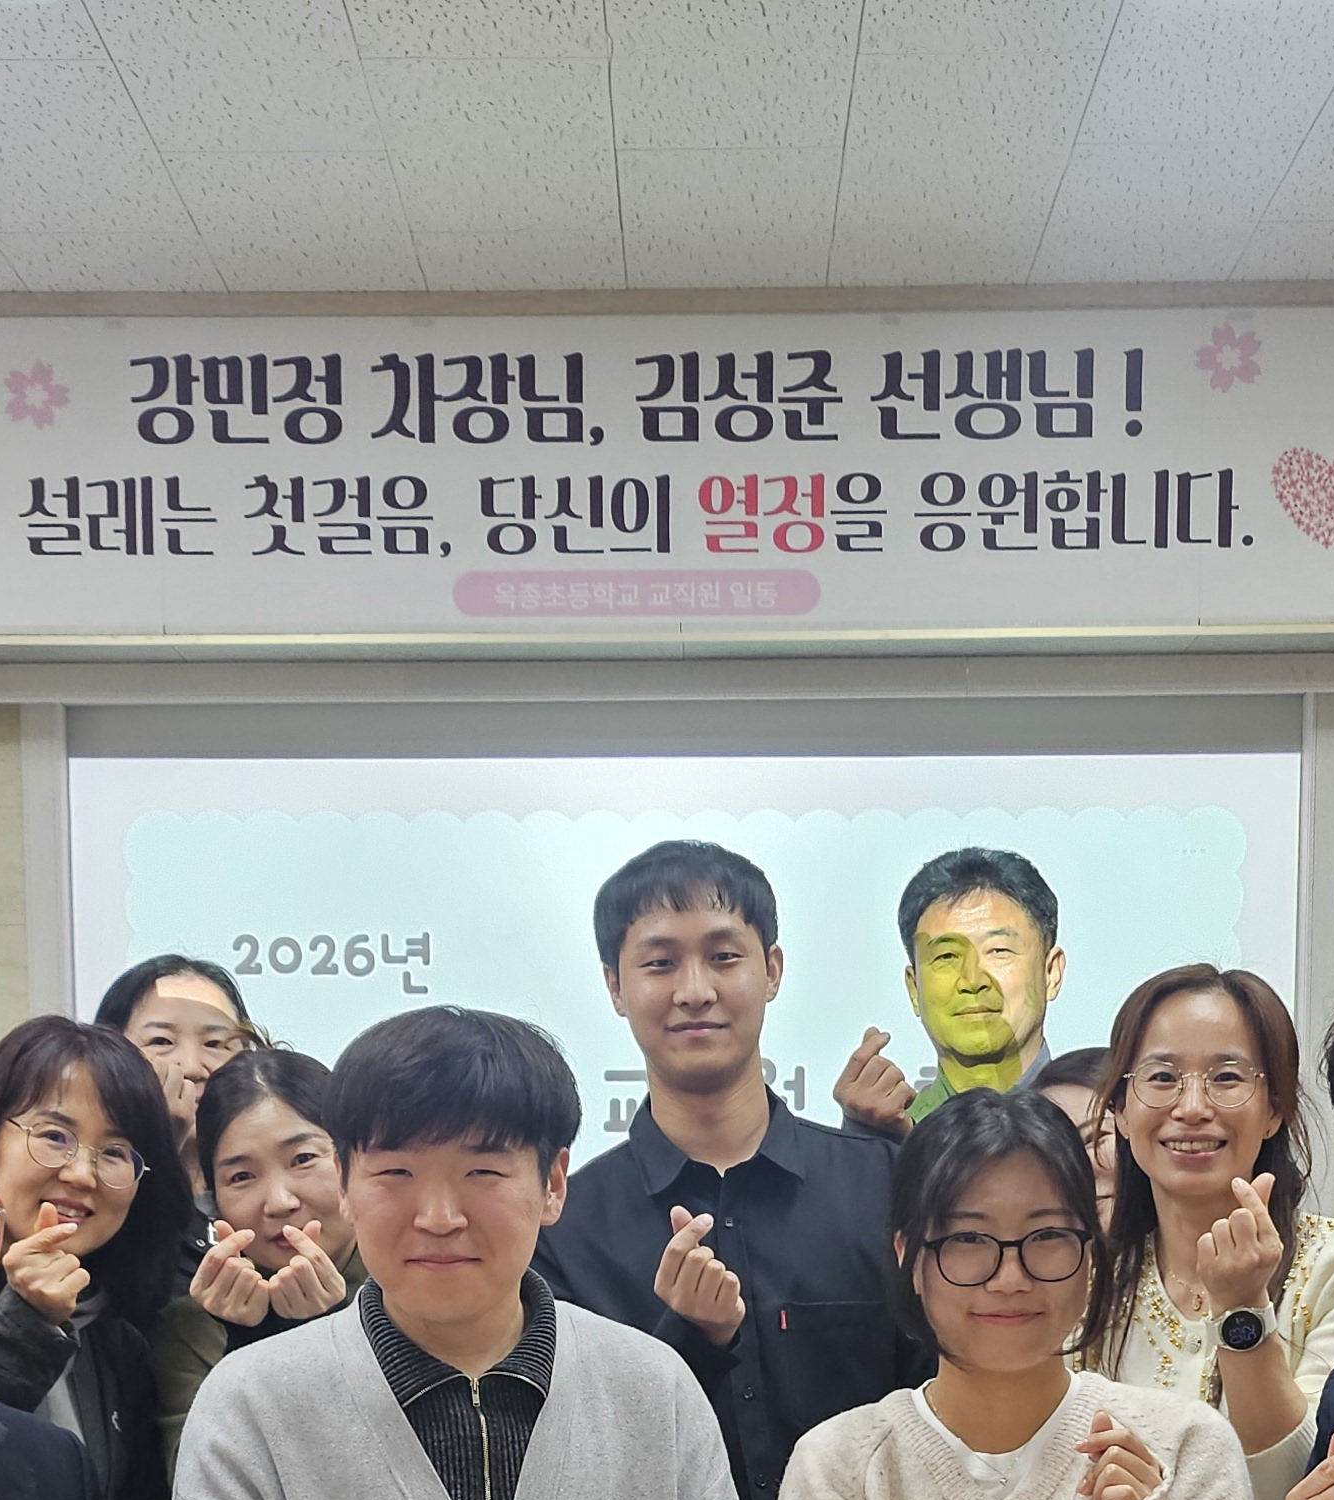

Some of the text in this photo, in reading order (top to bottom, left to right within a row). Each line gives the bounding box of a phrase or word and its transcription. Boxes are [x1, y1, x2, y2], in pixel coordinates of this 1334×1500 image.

[130, 353, 343, 444] 강민정
[371, 352, 605, 446] 차장님,
[635, 350, 843, 443] 김성준
[19, 468, 1254, 558] 설레는 첫걸음, 당신의 열정을 응원합니다.
[493, 580, 778, 610] 옥종초등학교 교직원 일동
[232, 931, 431, 995] 2026년
